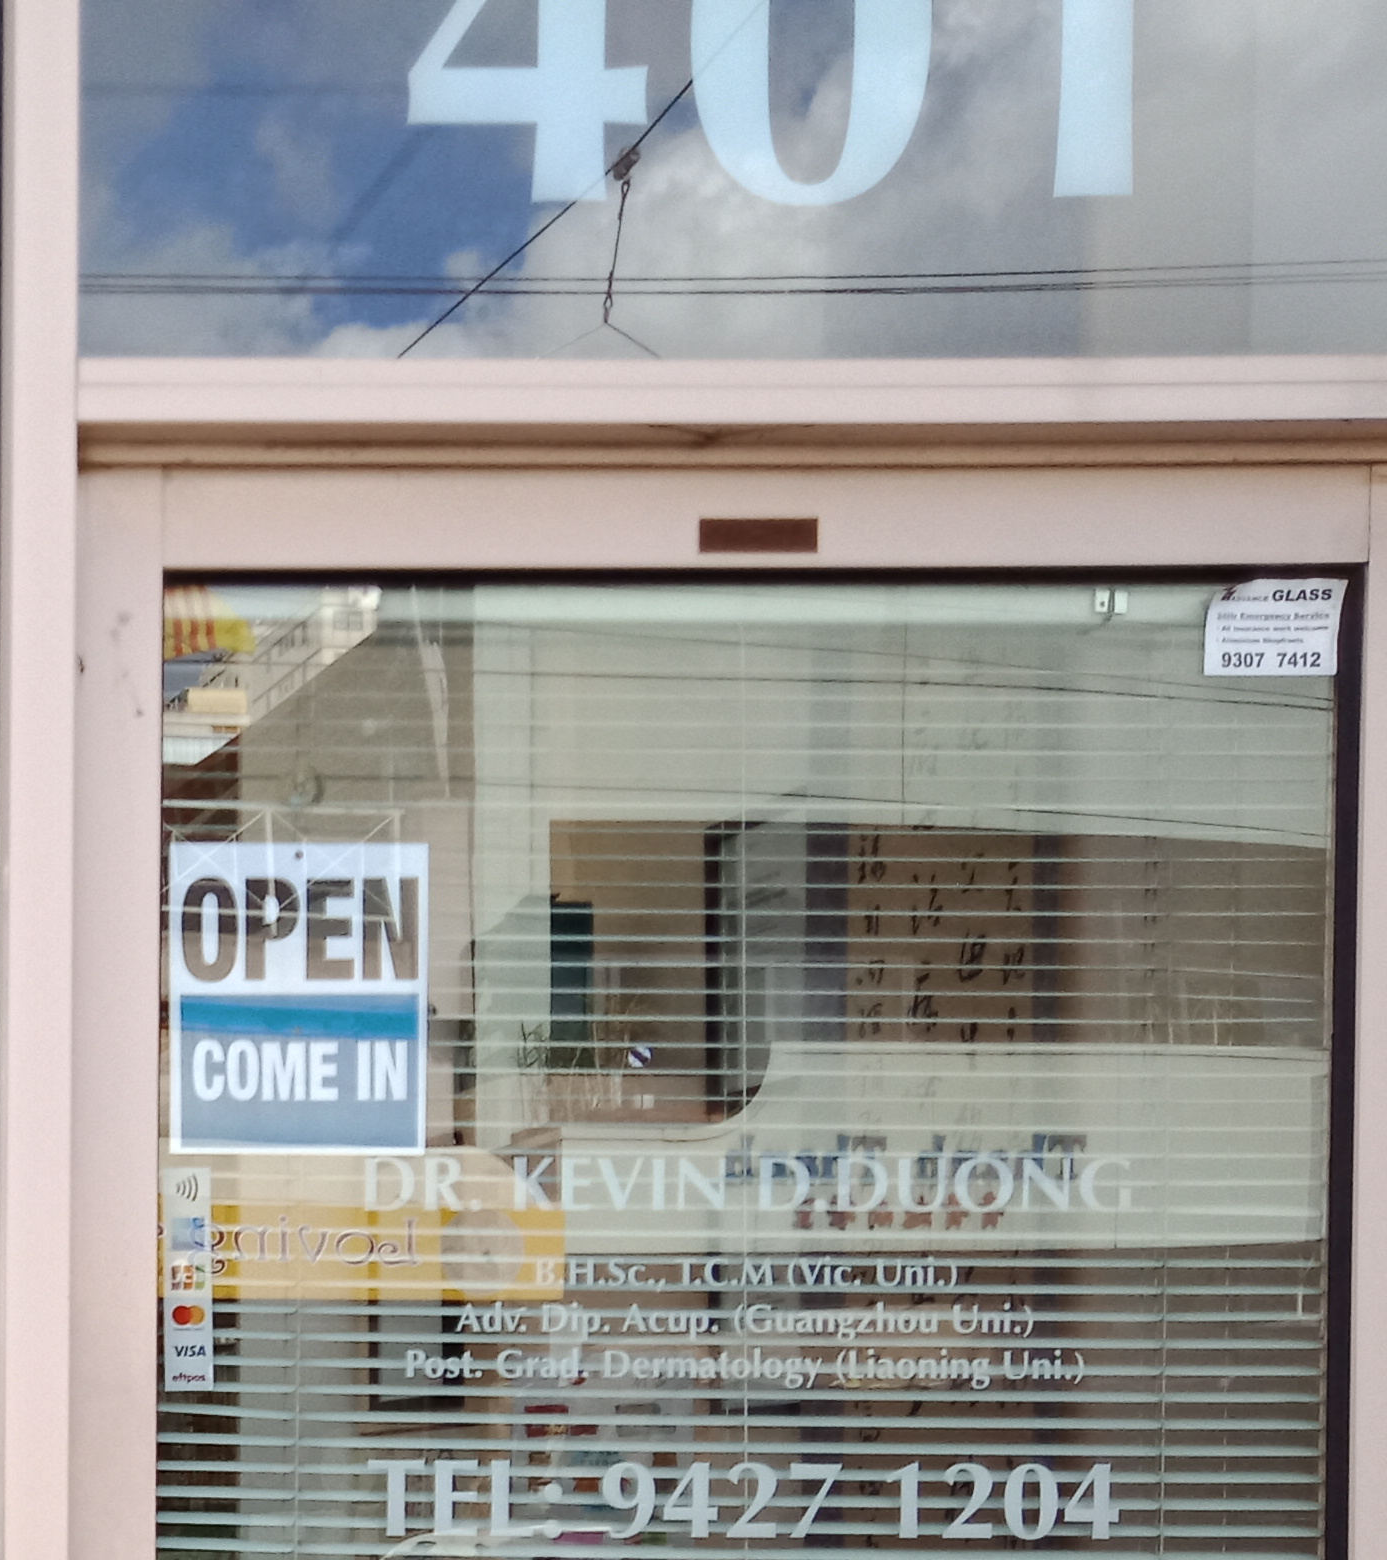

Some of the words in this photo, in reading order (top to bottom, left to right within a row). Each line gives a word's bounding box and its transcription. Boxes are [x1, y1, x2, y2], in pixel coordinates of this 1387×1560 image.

[1272, 588, 1332, 602] GLASS
[1221, 651, 1265, 668] 9307
[1277, 651, 1322, 668] 7412
[182, 876, 420, 983] OPEN
[192, 1039, 339, 1101] COME
[357, 1039, 409, 1101] IN
[364, 1156, 482, 1213] DR.
[514, 1155, 726, 1212] KEVIN
[874, 1257, 959, 1289] Uni.)
[455, 1302, 527, 1335] Adv.
[540, 1302, 611, 1341] Dip.
[623, 1303, 720, 1341] Acup.
[733, 1302, 939, 1341] (Guangzhou
[951, 1302, 1036, 1339] Uni.)
[174, 1345, 207, 1358] VISA
[404, 1349, 484, 1381] Post.
[495, 1348, 590, 1381] Grad.
[603, 1348, 824, 1390] Dermatology
[835, 1348, 991, 1390] (Liaoning
[1002, 1348, 1085, 1385] Uni.)
[601, 1461, 844, 1540] 9427
[885, 1461, 1122, 1541] 1204
